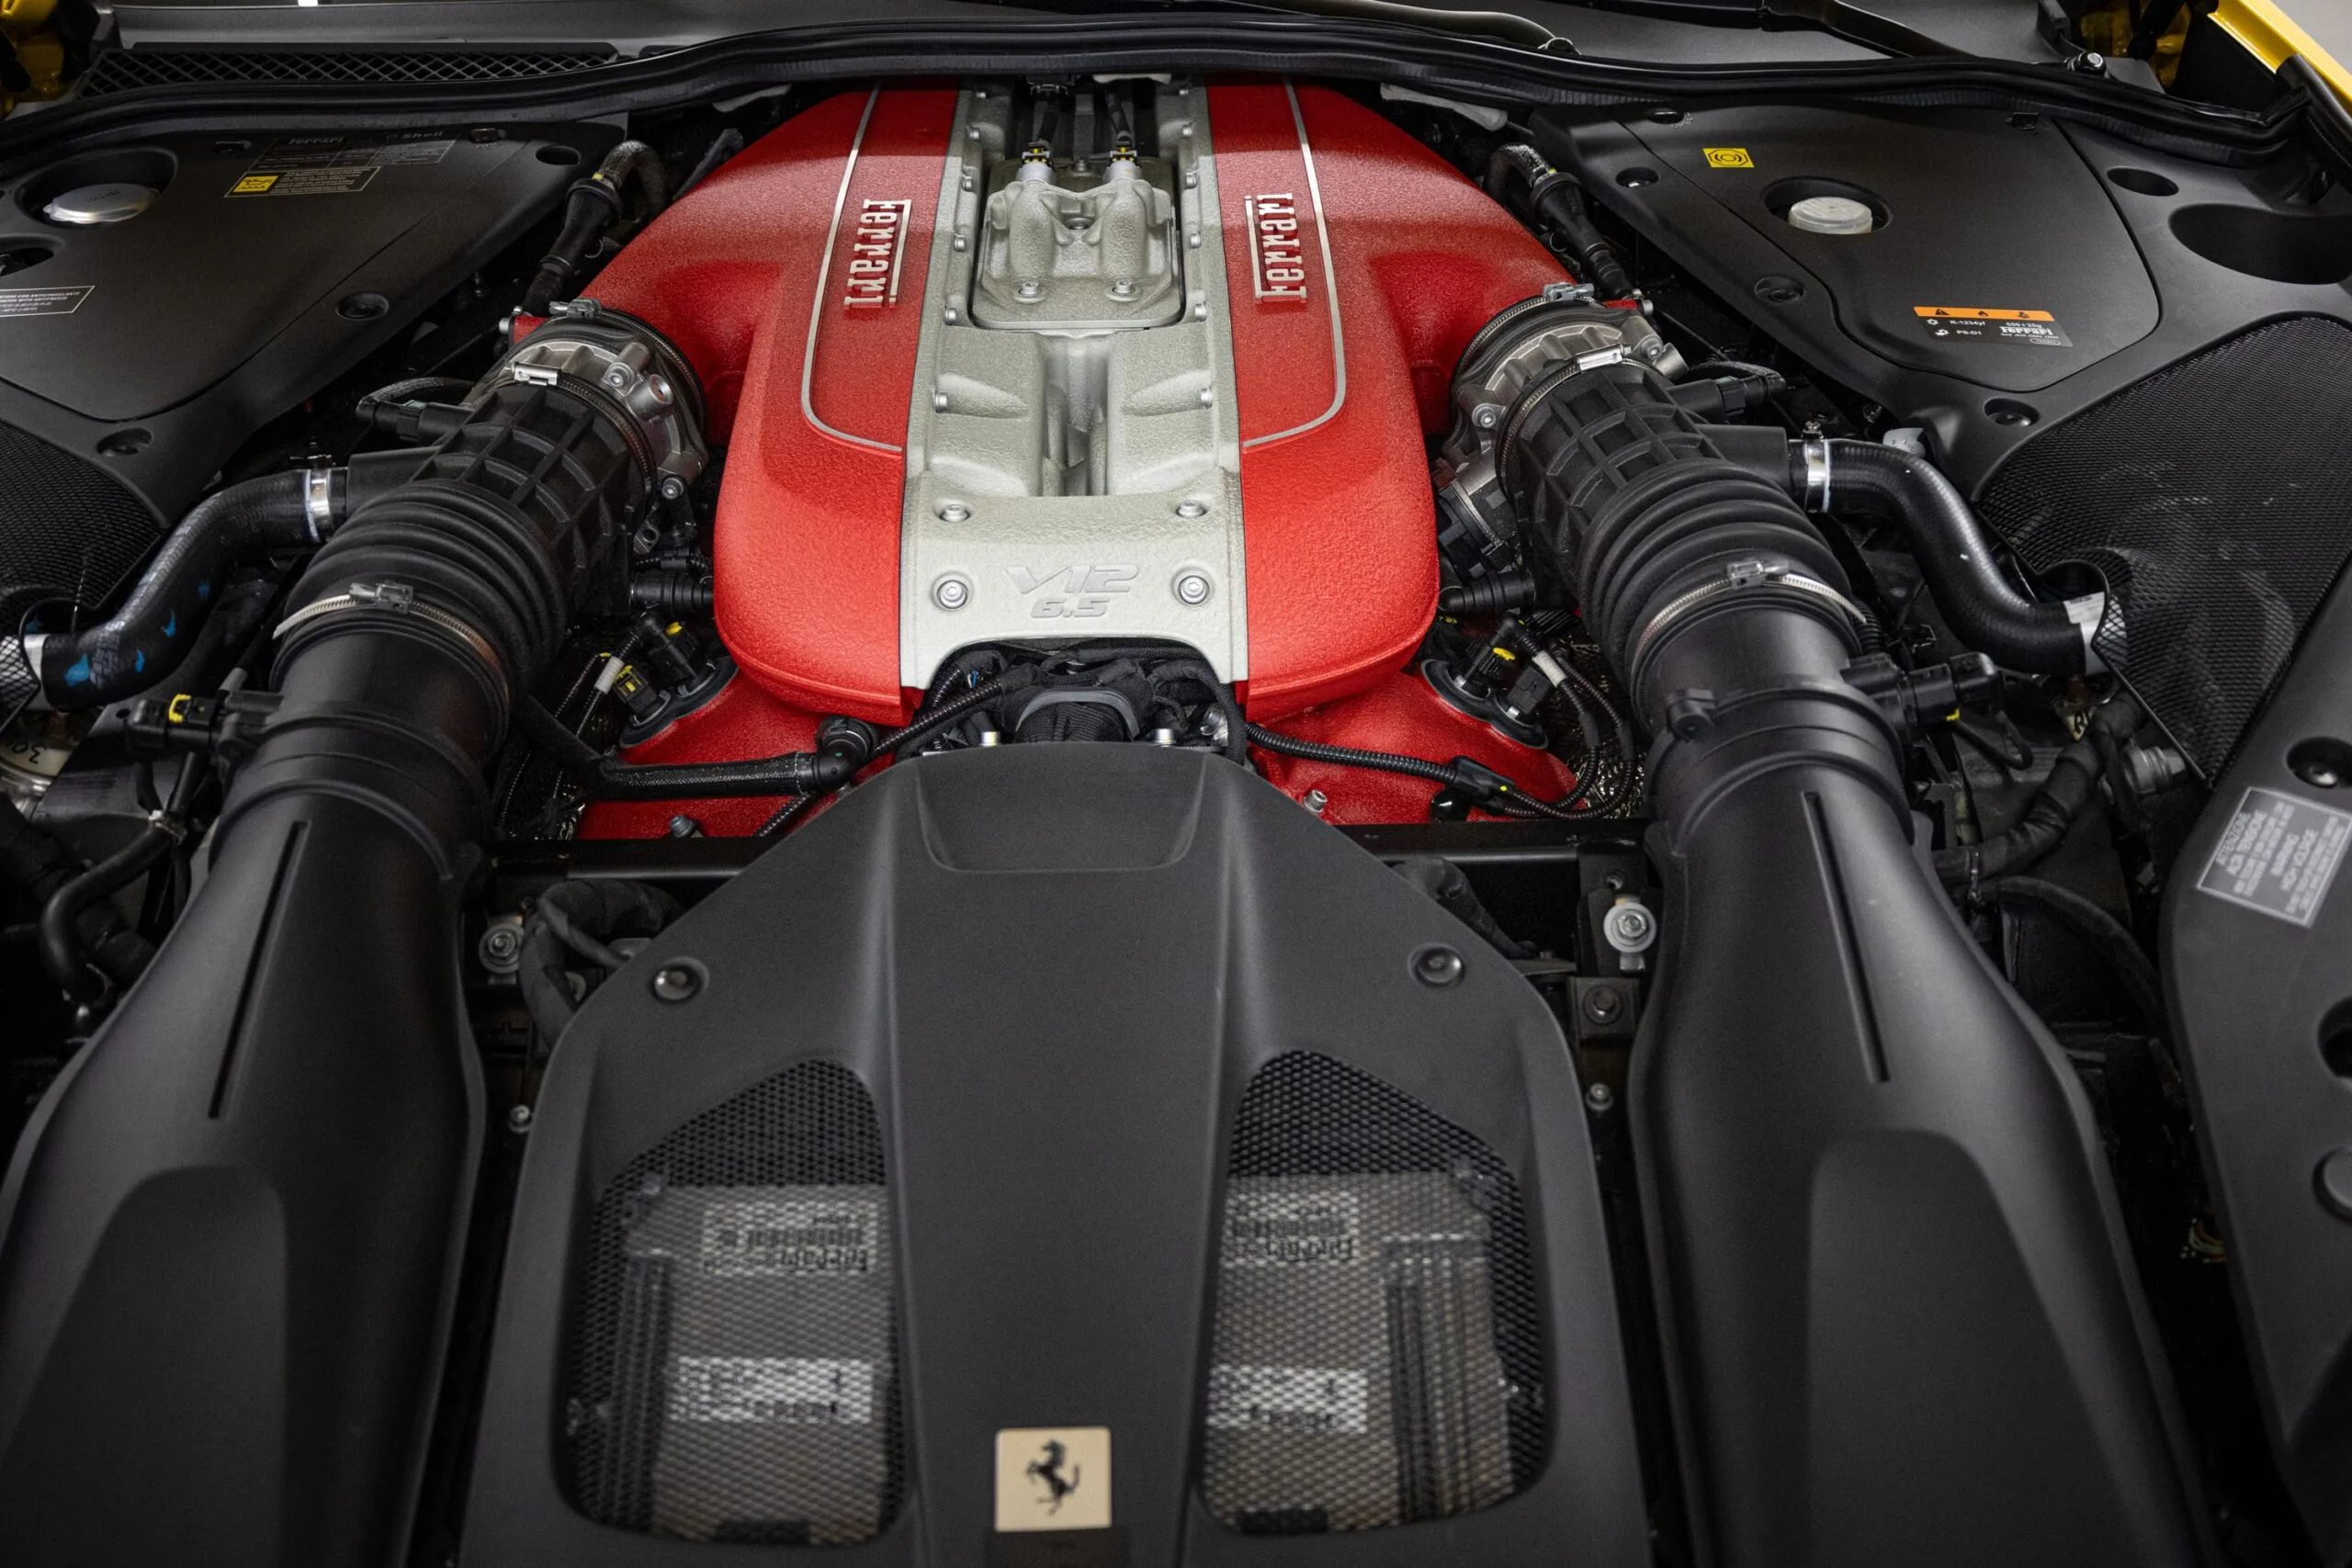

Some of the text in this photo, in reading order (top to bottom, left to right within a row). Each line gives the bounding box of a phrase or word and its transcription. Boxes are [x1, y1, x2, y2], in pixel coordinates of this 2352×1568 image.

[844, 198, 911, 306] Ferrari
[1244, 192, 1307, 299] Ferrari
[1998, 326, 2054, 336] Ferrari
[1005, 564, 1139, 594] V12
[1030, 596, 1111, 619] 6.5
